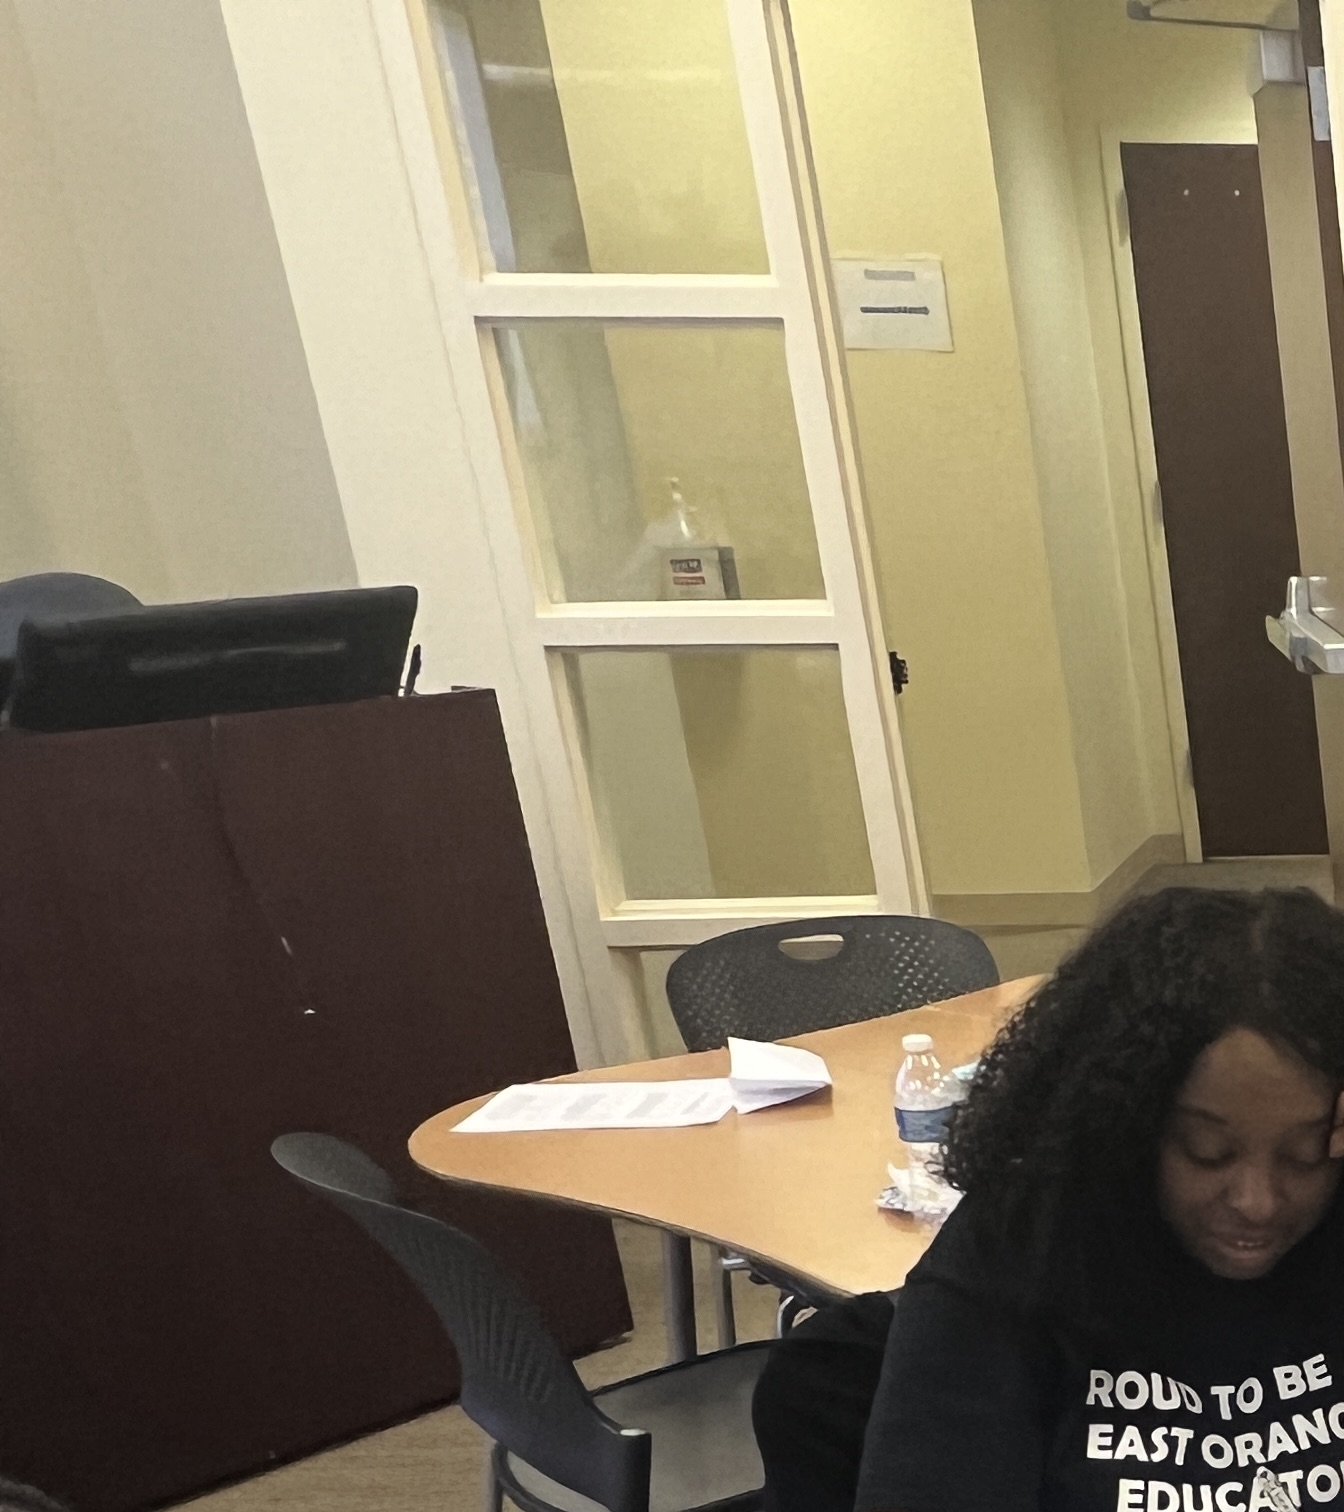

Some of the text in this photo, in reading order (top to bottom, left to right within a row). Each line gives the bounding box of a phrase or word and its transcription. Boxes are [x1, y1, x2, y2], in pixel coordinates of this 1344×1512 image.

[1086, 1370, 1202, 1413] ROUD
[1210, 1378, 1263, 1420] TO
[1273, 1353, 1332, 1400] BE
[1086, 1423, 1195, 1466] EAST
